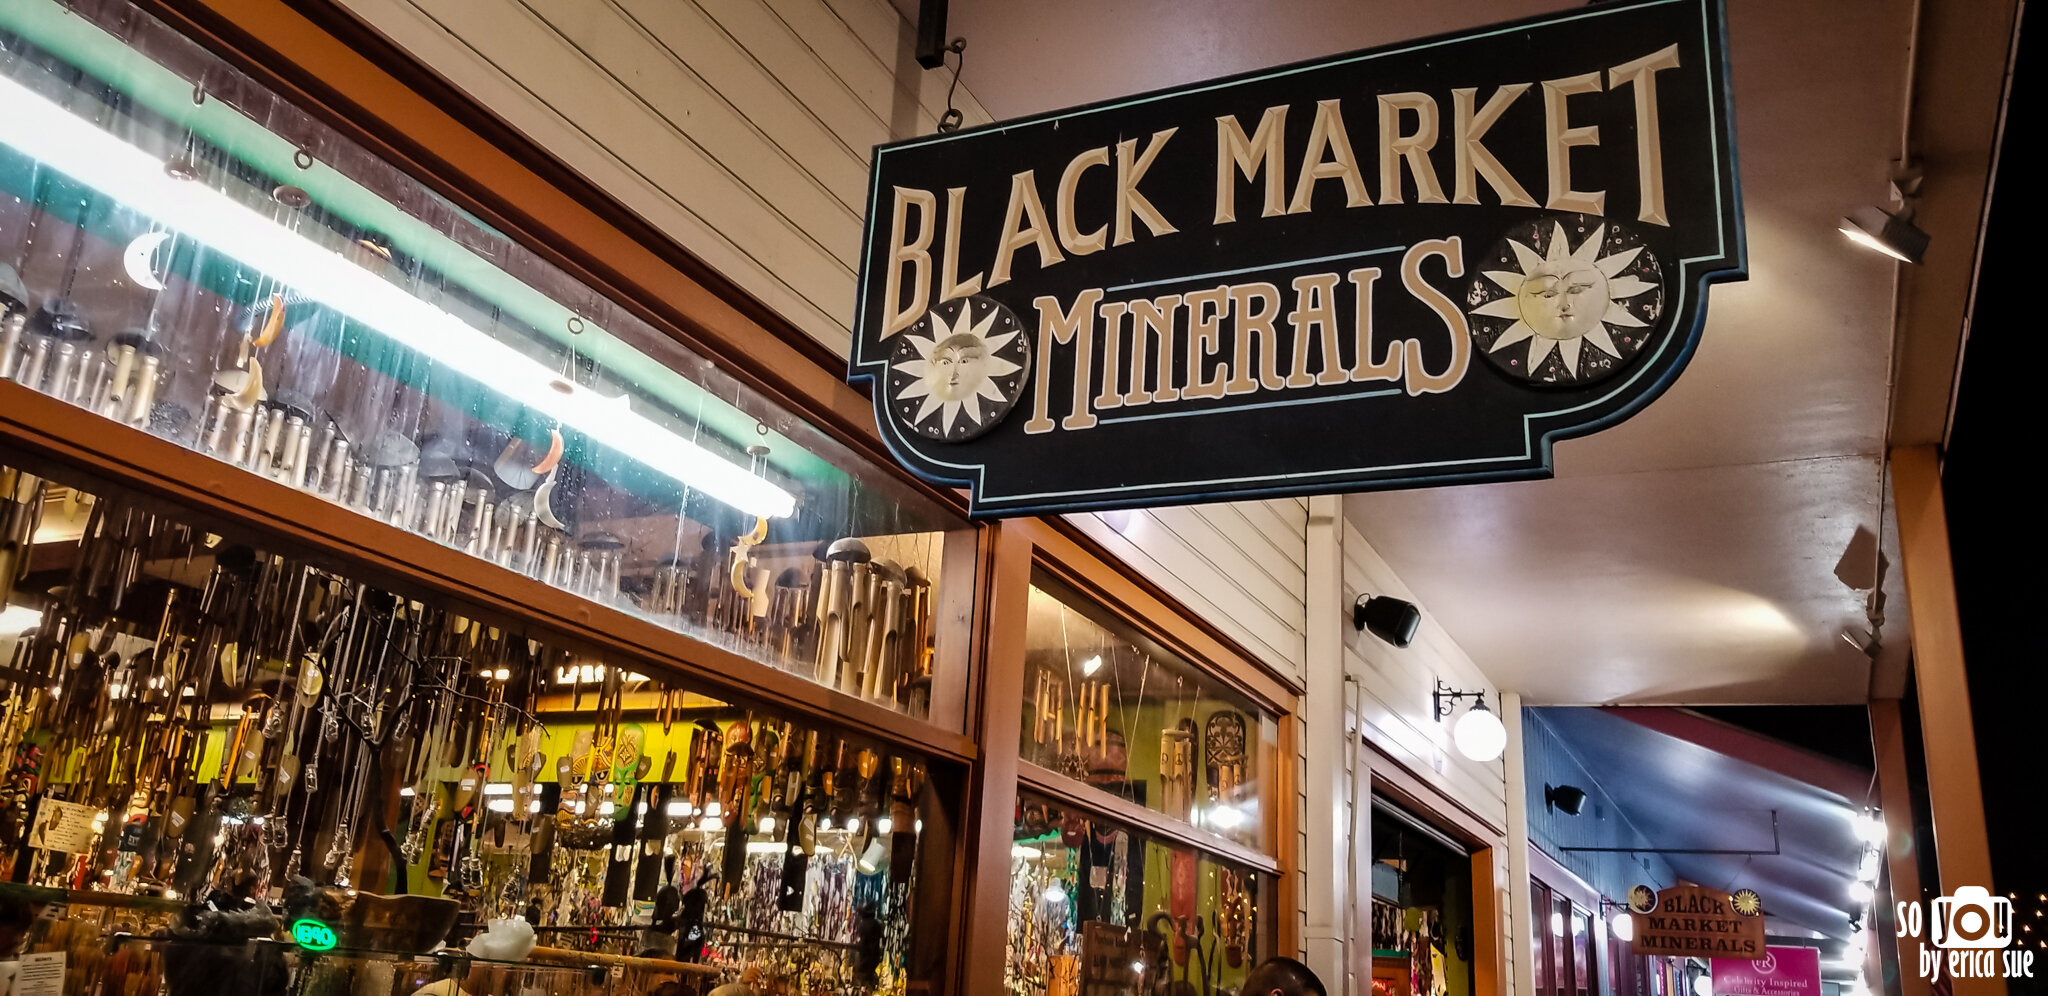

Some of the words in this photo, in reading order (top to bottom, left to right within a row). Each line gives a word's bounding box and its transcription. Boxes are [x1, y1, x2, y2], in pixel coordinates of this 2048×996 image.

[878, 127, 1179, 340] BLACK
[1213, 44, 1679, 226] MARKET
[1025, 235, 1471, 435] MINERALS
[1664, 895, 1724, 914] BLACK
[1648, 917, 1742, 933] MARKET
[1640, 935, 1756, 953] MINERALS
[1770, 978, 1808, 988] Inspired
